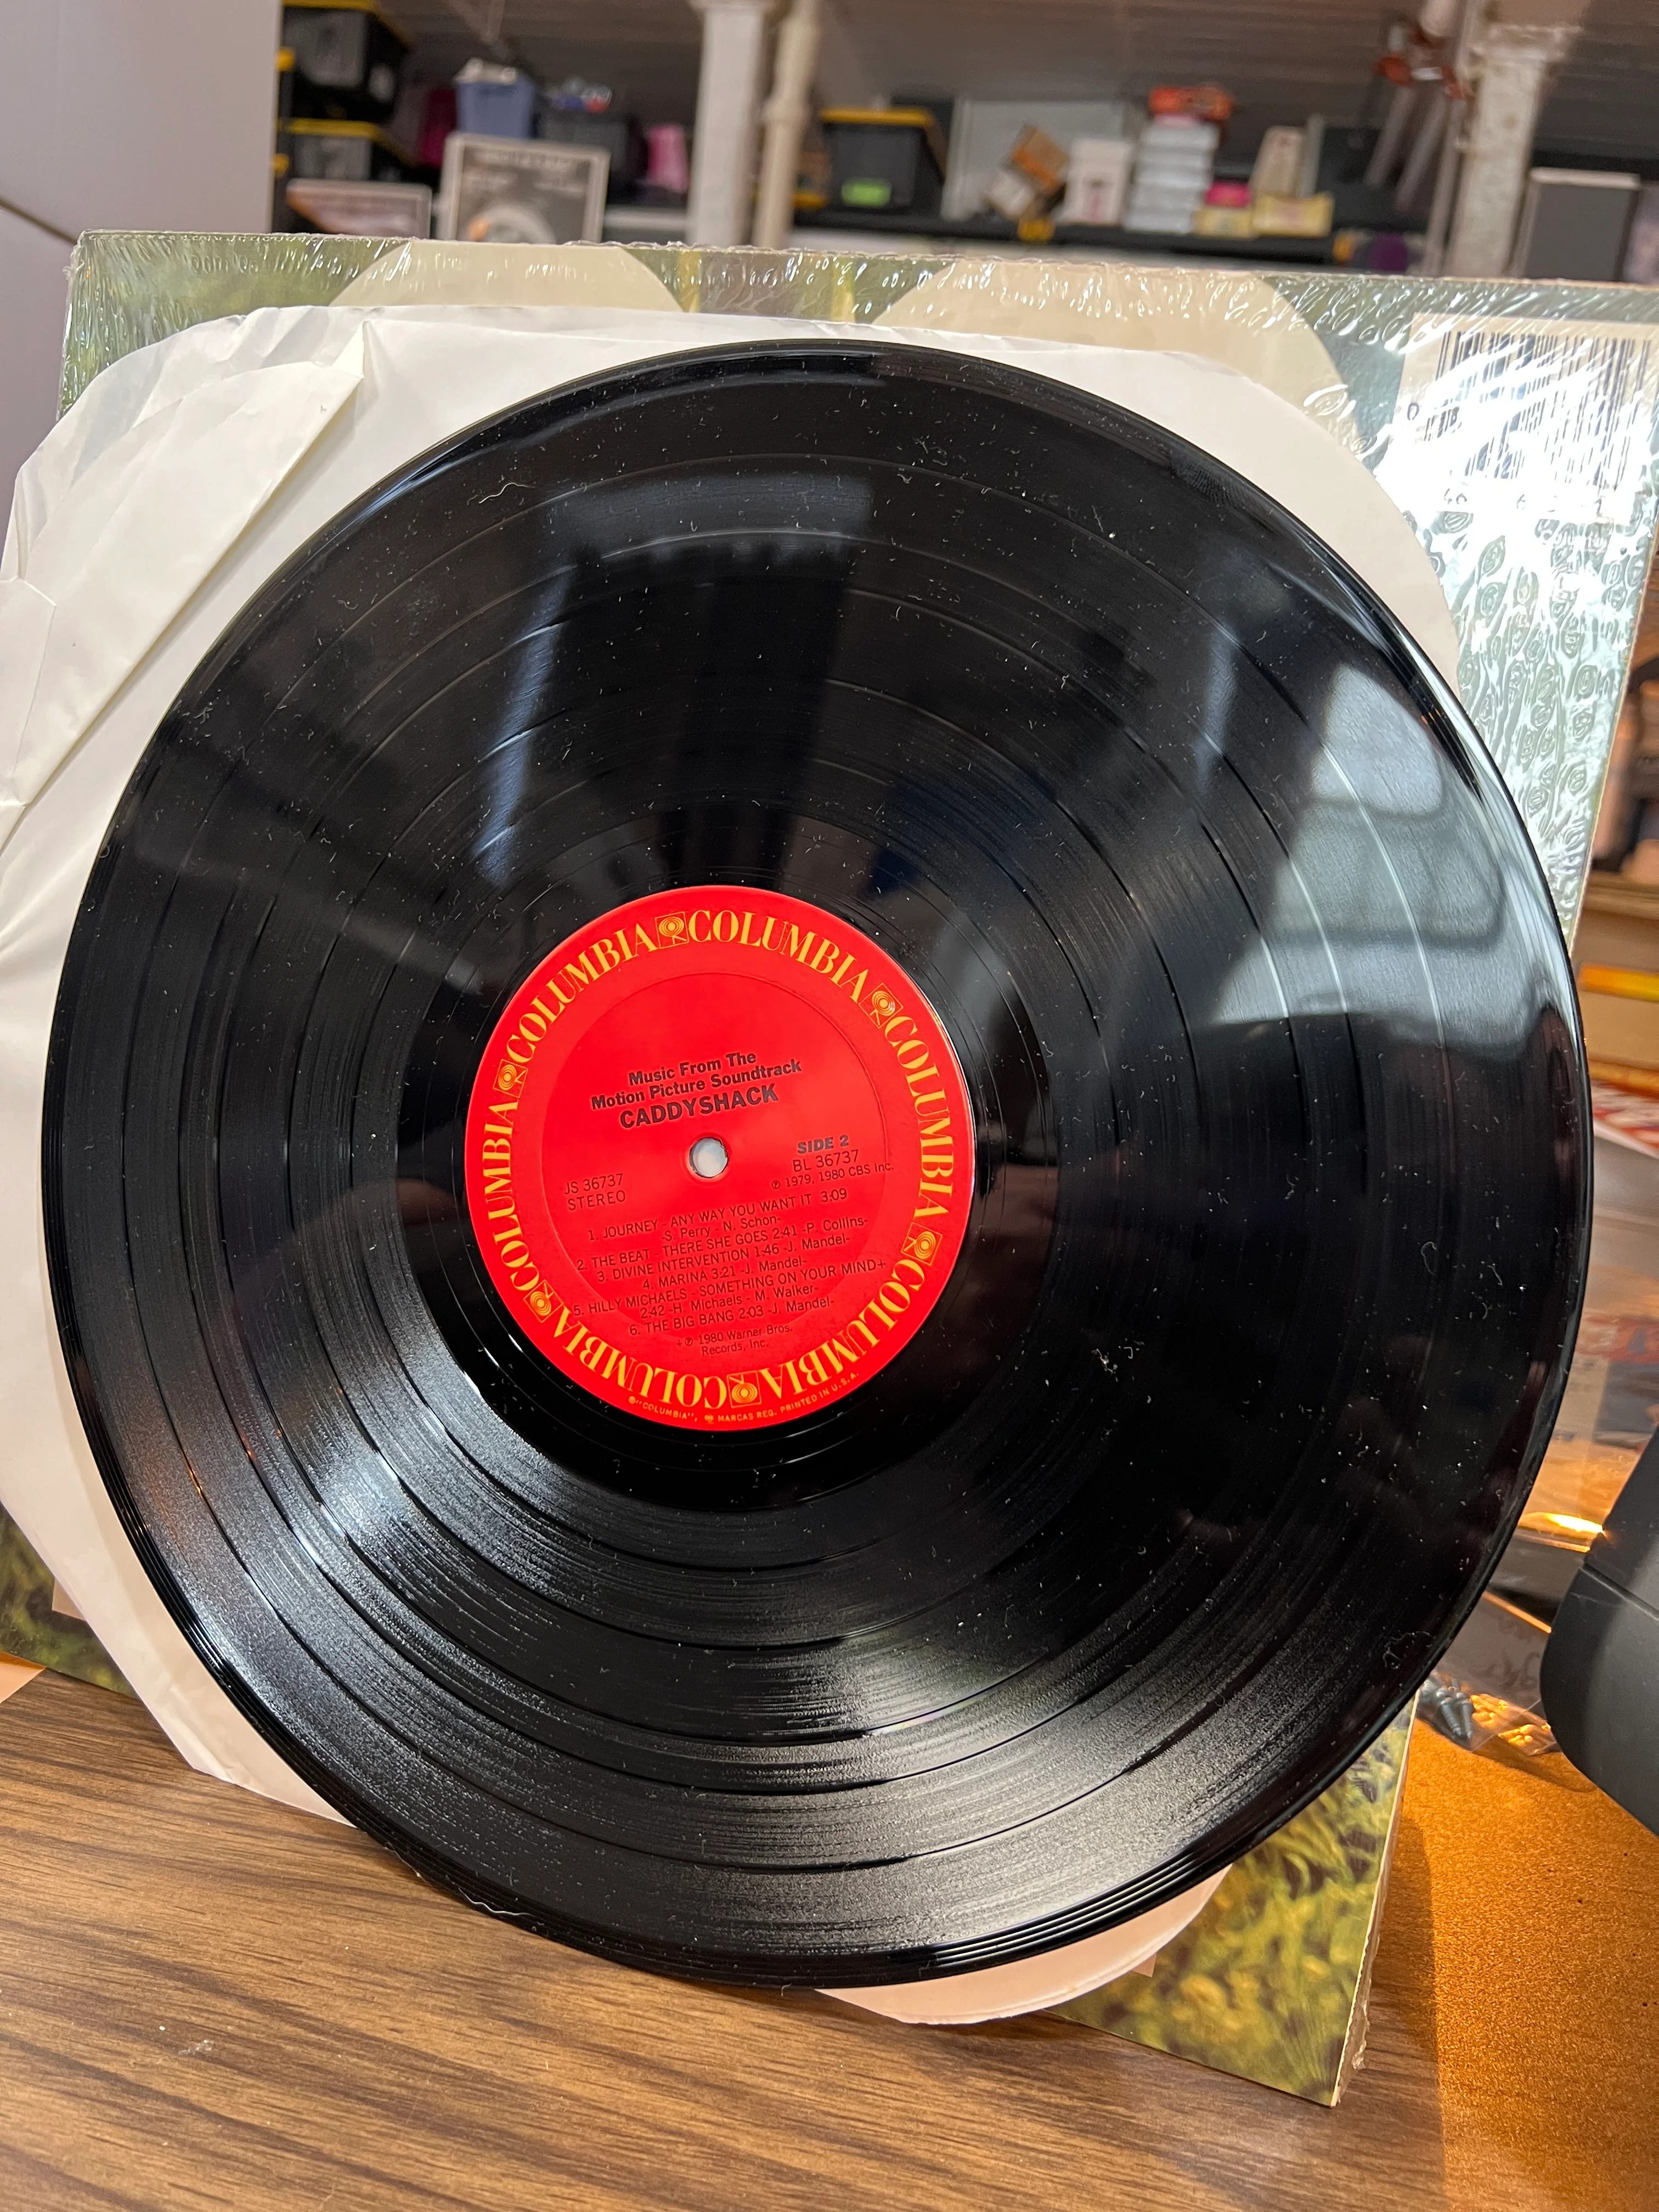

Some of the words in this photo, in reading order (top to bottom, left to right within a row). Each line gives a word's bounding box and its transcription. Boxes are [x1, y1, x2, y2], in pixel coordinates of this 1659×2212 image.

[688, 910, 868, 1004] COLUMBIA
[507, 923, 659, 1063] COLUMBIA
[591, 1091, 645, 1110] Motion
[650, 1081, 706, 1099] Picture
[710, 1059, 802, 1088] Soundtrack
[629, 1066, 675, 1086] Music
[679, 1059, 721, 1076] From
[725, 1052, 757, 1067] The
[620, 1084, 778, 1128] CADDYSHACK
[884, 1016, 954, 1220] COLUMBIA
[793, 1158, 811, 1172] BL
[815, 1149, 859, 1168] 36737
[797, 1137, 834, 1154] SIDE
[839, 1135, 849, 1147] 2
[482, 1099, 539, 1291] COLUMBIA
[565, 1181, 579, 1195] JS
[583, 1173, 623, 1192] 36737
[786, 1173, 815, 1187] 1979,
[819, 1168, 845, 1182] 1980
[848, 1164, 871, 1177] CBS
[874, 1163, 894, 1172] Inc.
[568, 1190, 625, 1211] STEREO
[589, 1229, 599, 1240] 1.
[603, 1219, 658, 1239] JOURNEY
[670, 1212, 695, 1227] ANY
[698, 1207, 725, 1222] WAY
[729, 1203, 755, 1217] YOU
[759, 1196, 795, 1212] WANT
[800, 1194, 812, 1206] IT
[820, 1188, 847, 1203] 3:09
[577, 1259, 588, 1271] 2.
[591, 1254, 616, 1268] THE
[619, 1249, 650, 1264] BEAT
[662, 1240, 703, 1256] THERE
[707, 1235, 731, 1250] SHE
[735, 1229, 768, 1245] GOES
[772, 1224, 798, 1240] 2:41
[823, 1216, 868, 1232] Collins-
[680, 1226, 710, 1239] Perry
[723, 1220, 736, 1232] N.
[741, 1215, 781, 1229] Schon-
[597, 1271, 608, 1282] 3.
[613, 1263, 654, 1279] DIVINE
[658, 1248, 749, 1272] INTERVENTION
[802, 1233, 850, 1250] Mandel-
[643, 1279, 653, 1290] 4.
[658, 1269, 708, 1288] MARINA
[711, 1265, 736, 1279] 3:21
[759, 1255, 807, 1272] Mandel-
[574, 1305, 584, 1316] 5.
[588, 1297, 622, 1314] HILLY
[625, 1288, 687, 1308] MICHAELS
[699, 1274, 774, 1297] SOMETHING
[778, 1272, 797, 1285] ON
[800, 1265, 837, 1280] YOUR
[640, 1305, 665, 1319] 2:42
[691, 1294, 743, 1311] Michaels
[755, 1290, 769, 1301] M.
[774, 1284, 819, 1299] Walker-
[629, 1324, 641, 1335] 6.
[645, 1319, 669, 1333] THE
[674, 1316, 695, 1329] BIG
[699, 1310, 734, 1325] BANG
[739, 1305, 763, 1320] 2:03
[786, 1296, 834, 1313] Mandel-
[698, 1331, 724, 1345] 1980
[726, 1327, 762, 1340] Warner
[766, 1324, 793, 1335] Bros.
[758, 1259, 925, 1399] COLUMBIA
[553, 1304, 727, 1409] COLUMBIA
[702, 1341, 746, 1357] Records,
[750, 1339, 769, 1349] Inc.
[718, 1412, 754, 1423] MARCAS
[757, 1409, 777, 1420] REG.
[780, 1394, 818, 1413] PRINTED
[819, 1388, 830, 1398] IN
[831, 1372, 860, 1391] U.S.A.
